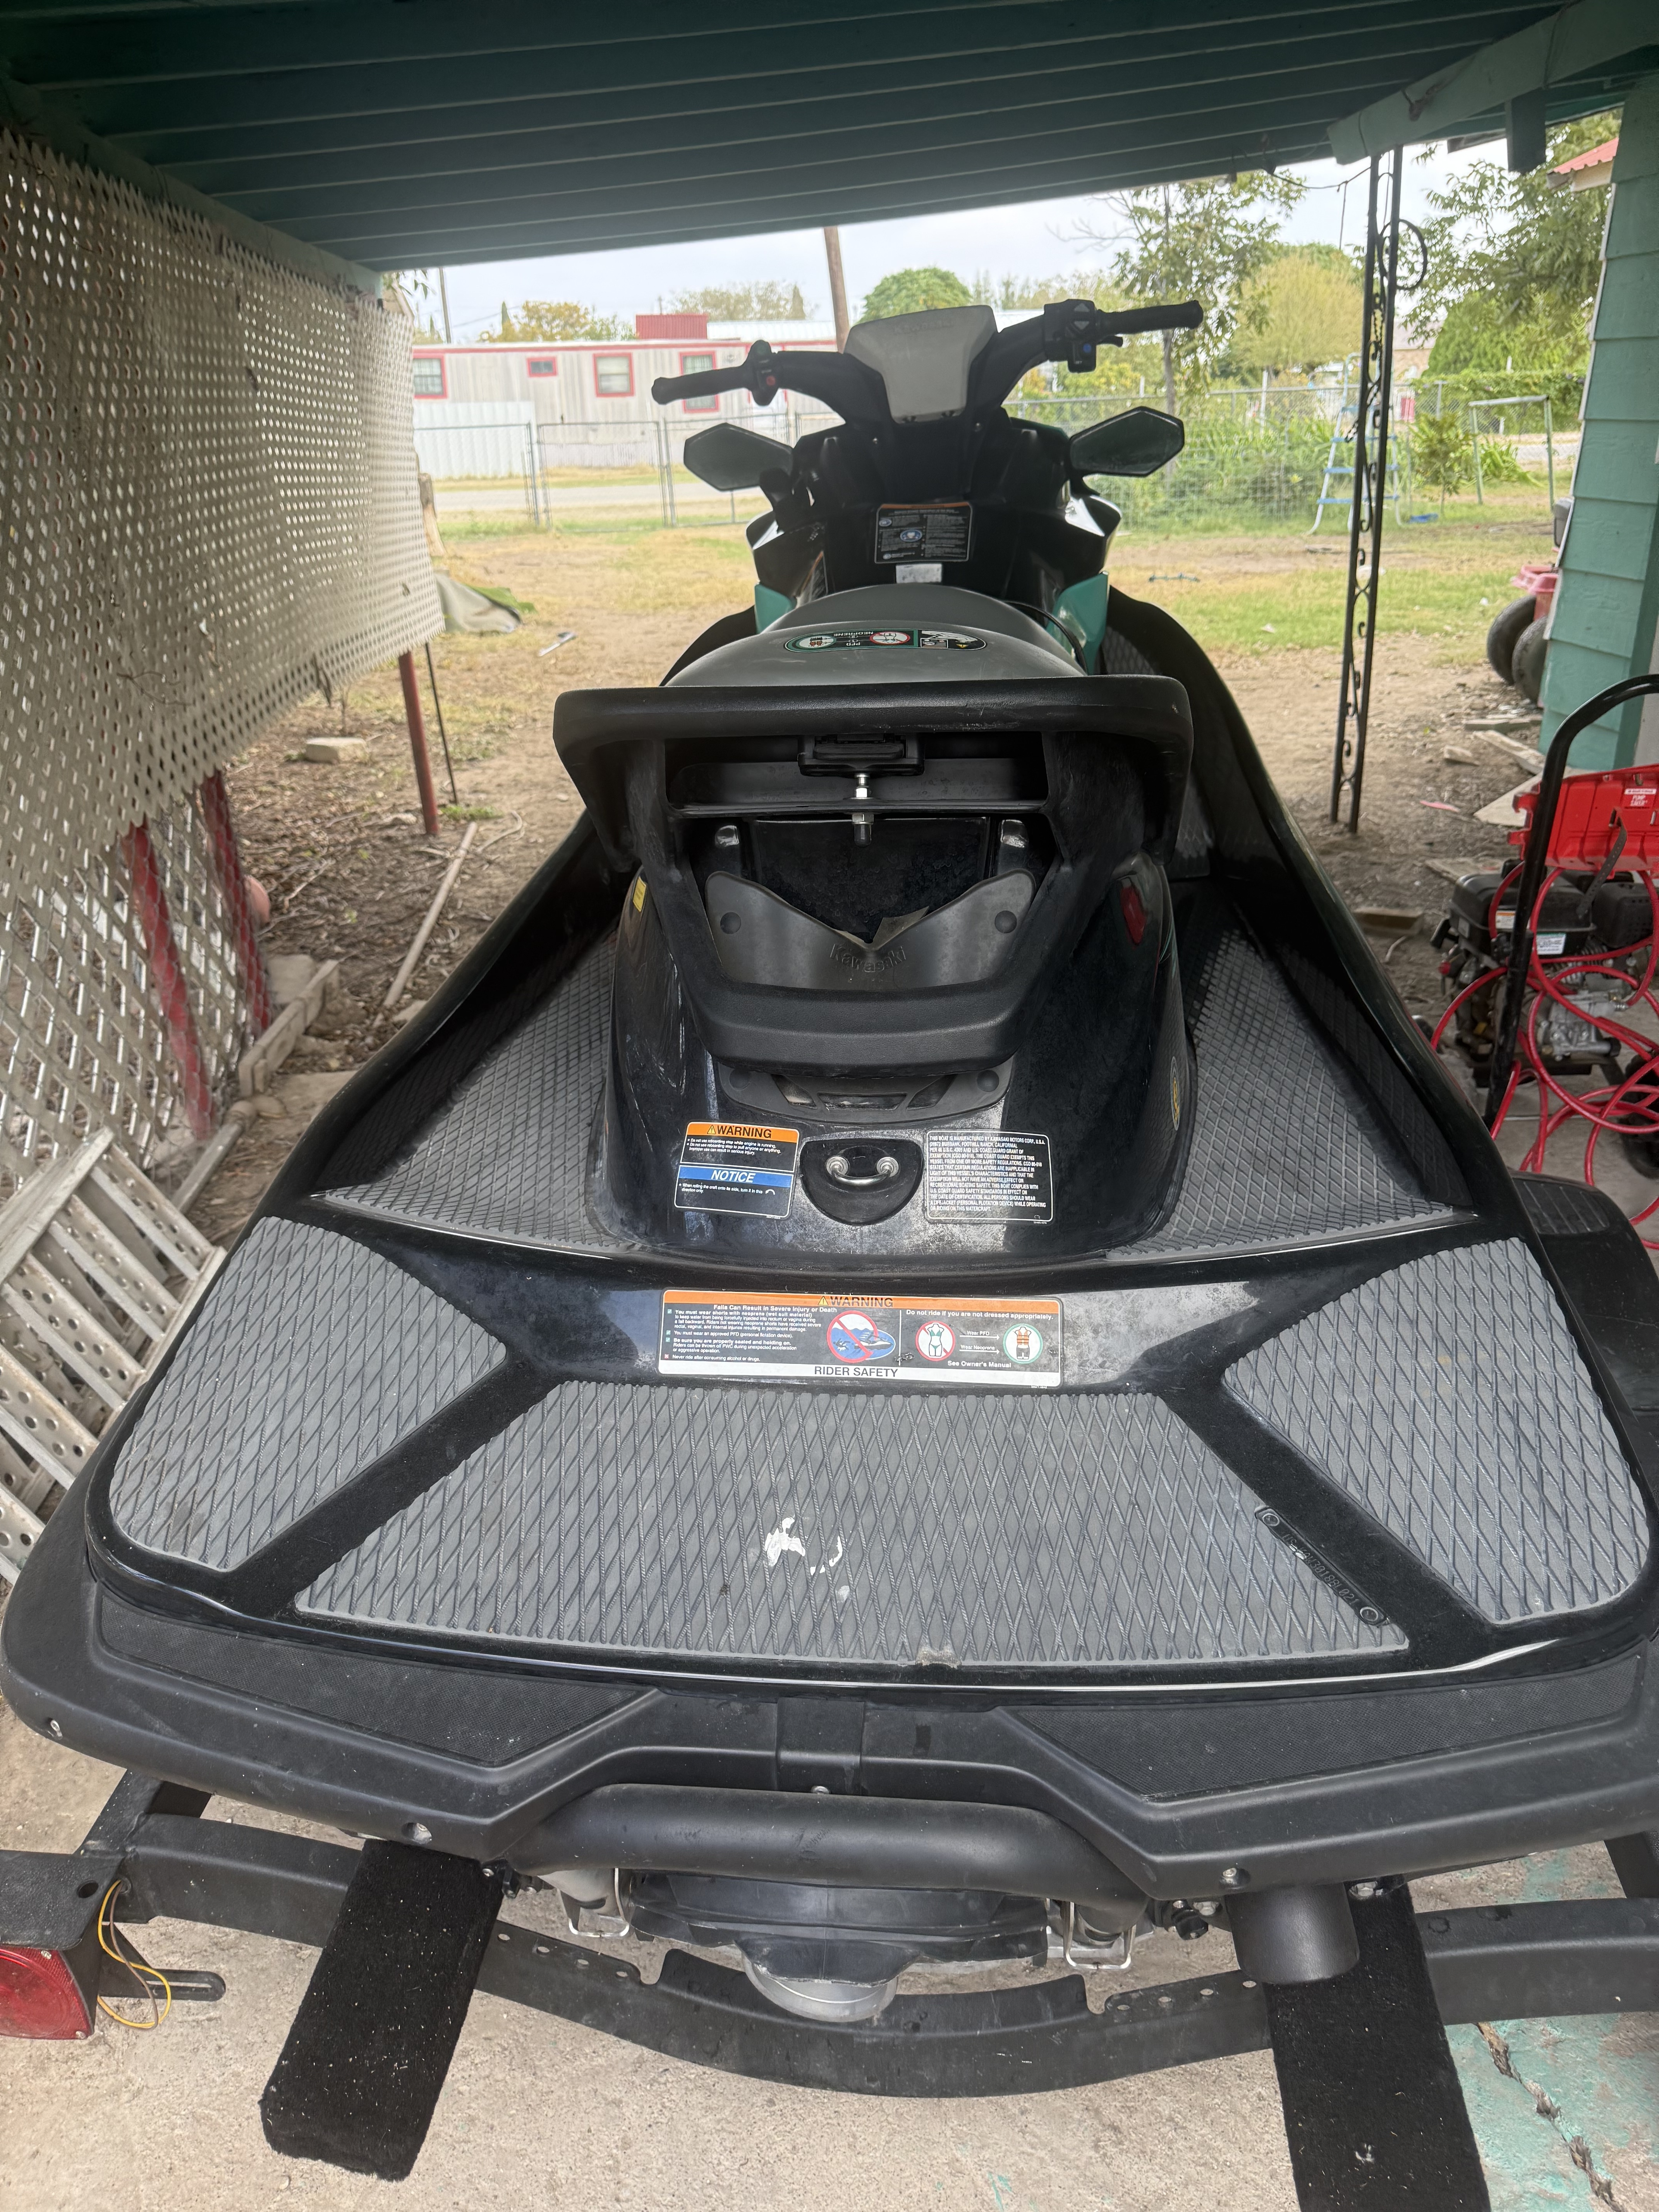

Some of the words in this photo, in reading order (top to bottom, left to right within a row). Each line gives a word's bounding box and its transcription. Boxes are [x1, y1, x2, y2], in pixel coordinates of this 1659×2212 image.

[830, 943, 906, 973] Kawasaki
[717, 1125, 772, 1139] WARNING
[711, 1170, 756, 1183] NOTICE
[830, 1296, 893, 1307] WARNING
[814, 1366, 850, 1376] RIDER
[853, 1367, 898, 1377] SAFETY
